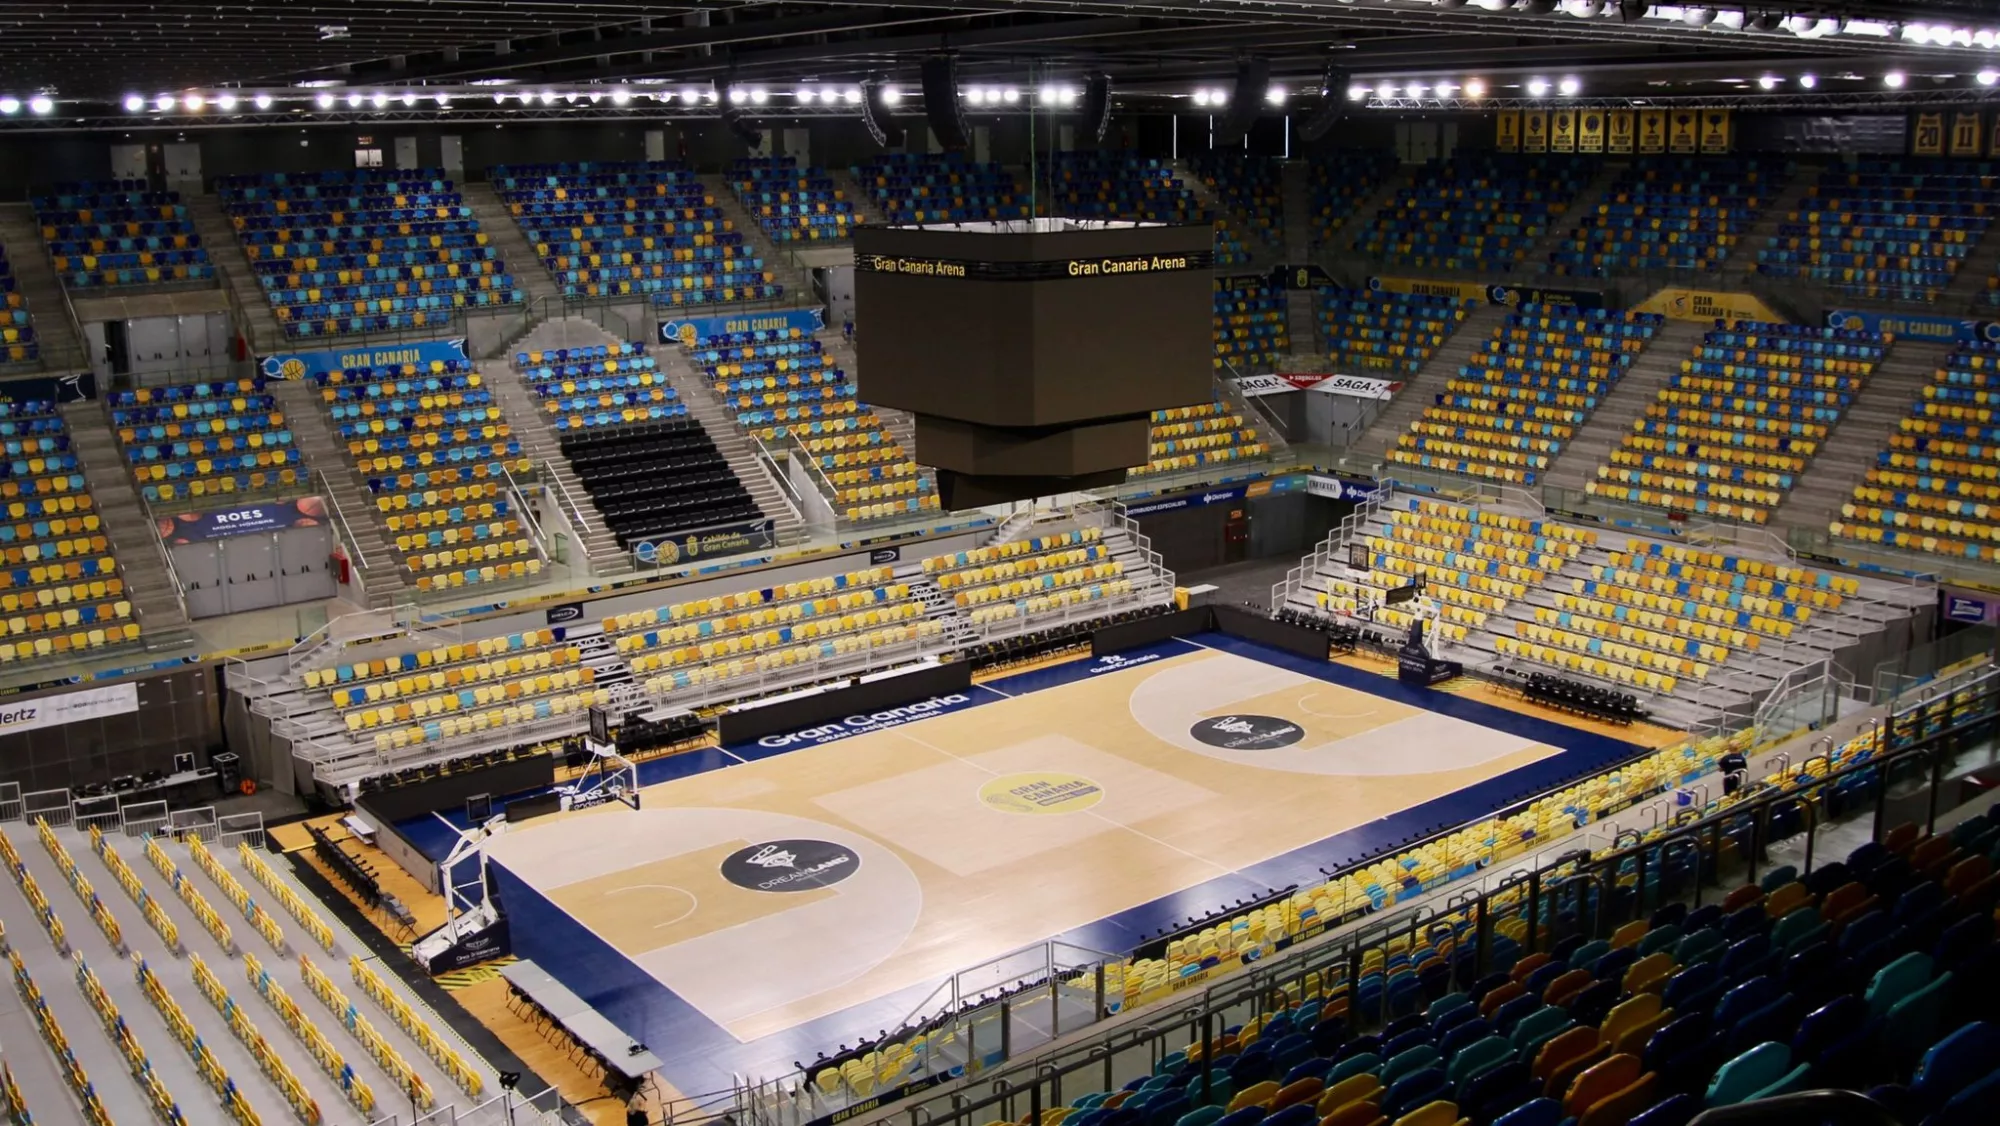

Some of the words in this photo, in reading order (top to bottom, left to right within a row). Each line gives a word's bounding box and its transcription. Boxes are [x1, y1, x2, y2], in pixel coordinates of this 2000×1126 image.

[874, 258, 896, 273] Gran
[898, 259, 934, 275] Canaria
[935, 261, 966, 277] Arena
[1068, 261, 1099, 276] Gran
[1102, 257, 1148, 274] Canaria
[1151, 255, 1186, 270] Arena
[725, 320, 749, 333] GRAN
[752, 316, 787, 331] CANARIA
[342, 353, 370, 369] GRAN
[375, 349, 420, 366] CANARIA
[1333, 378, 1372, 390] SAGA
[216, 509, 263, 523] ROES
[702, 533, 730, 544] Cabildo
[703, 542, 721, 553] Gran
[722, 538, 749, 549] Canaria
[758, 722, 844, 747] Gran
[844, 693, 970, 727] Canaria
[816, 730, 852, 744] GRAN
[852, 718, 903, 736] CANARIA
[903, 710, 942, 723] ARENA
[832, 1109, 850, 1124] GRAN
[851, 1097, 880, 1116] CANARIA
